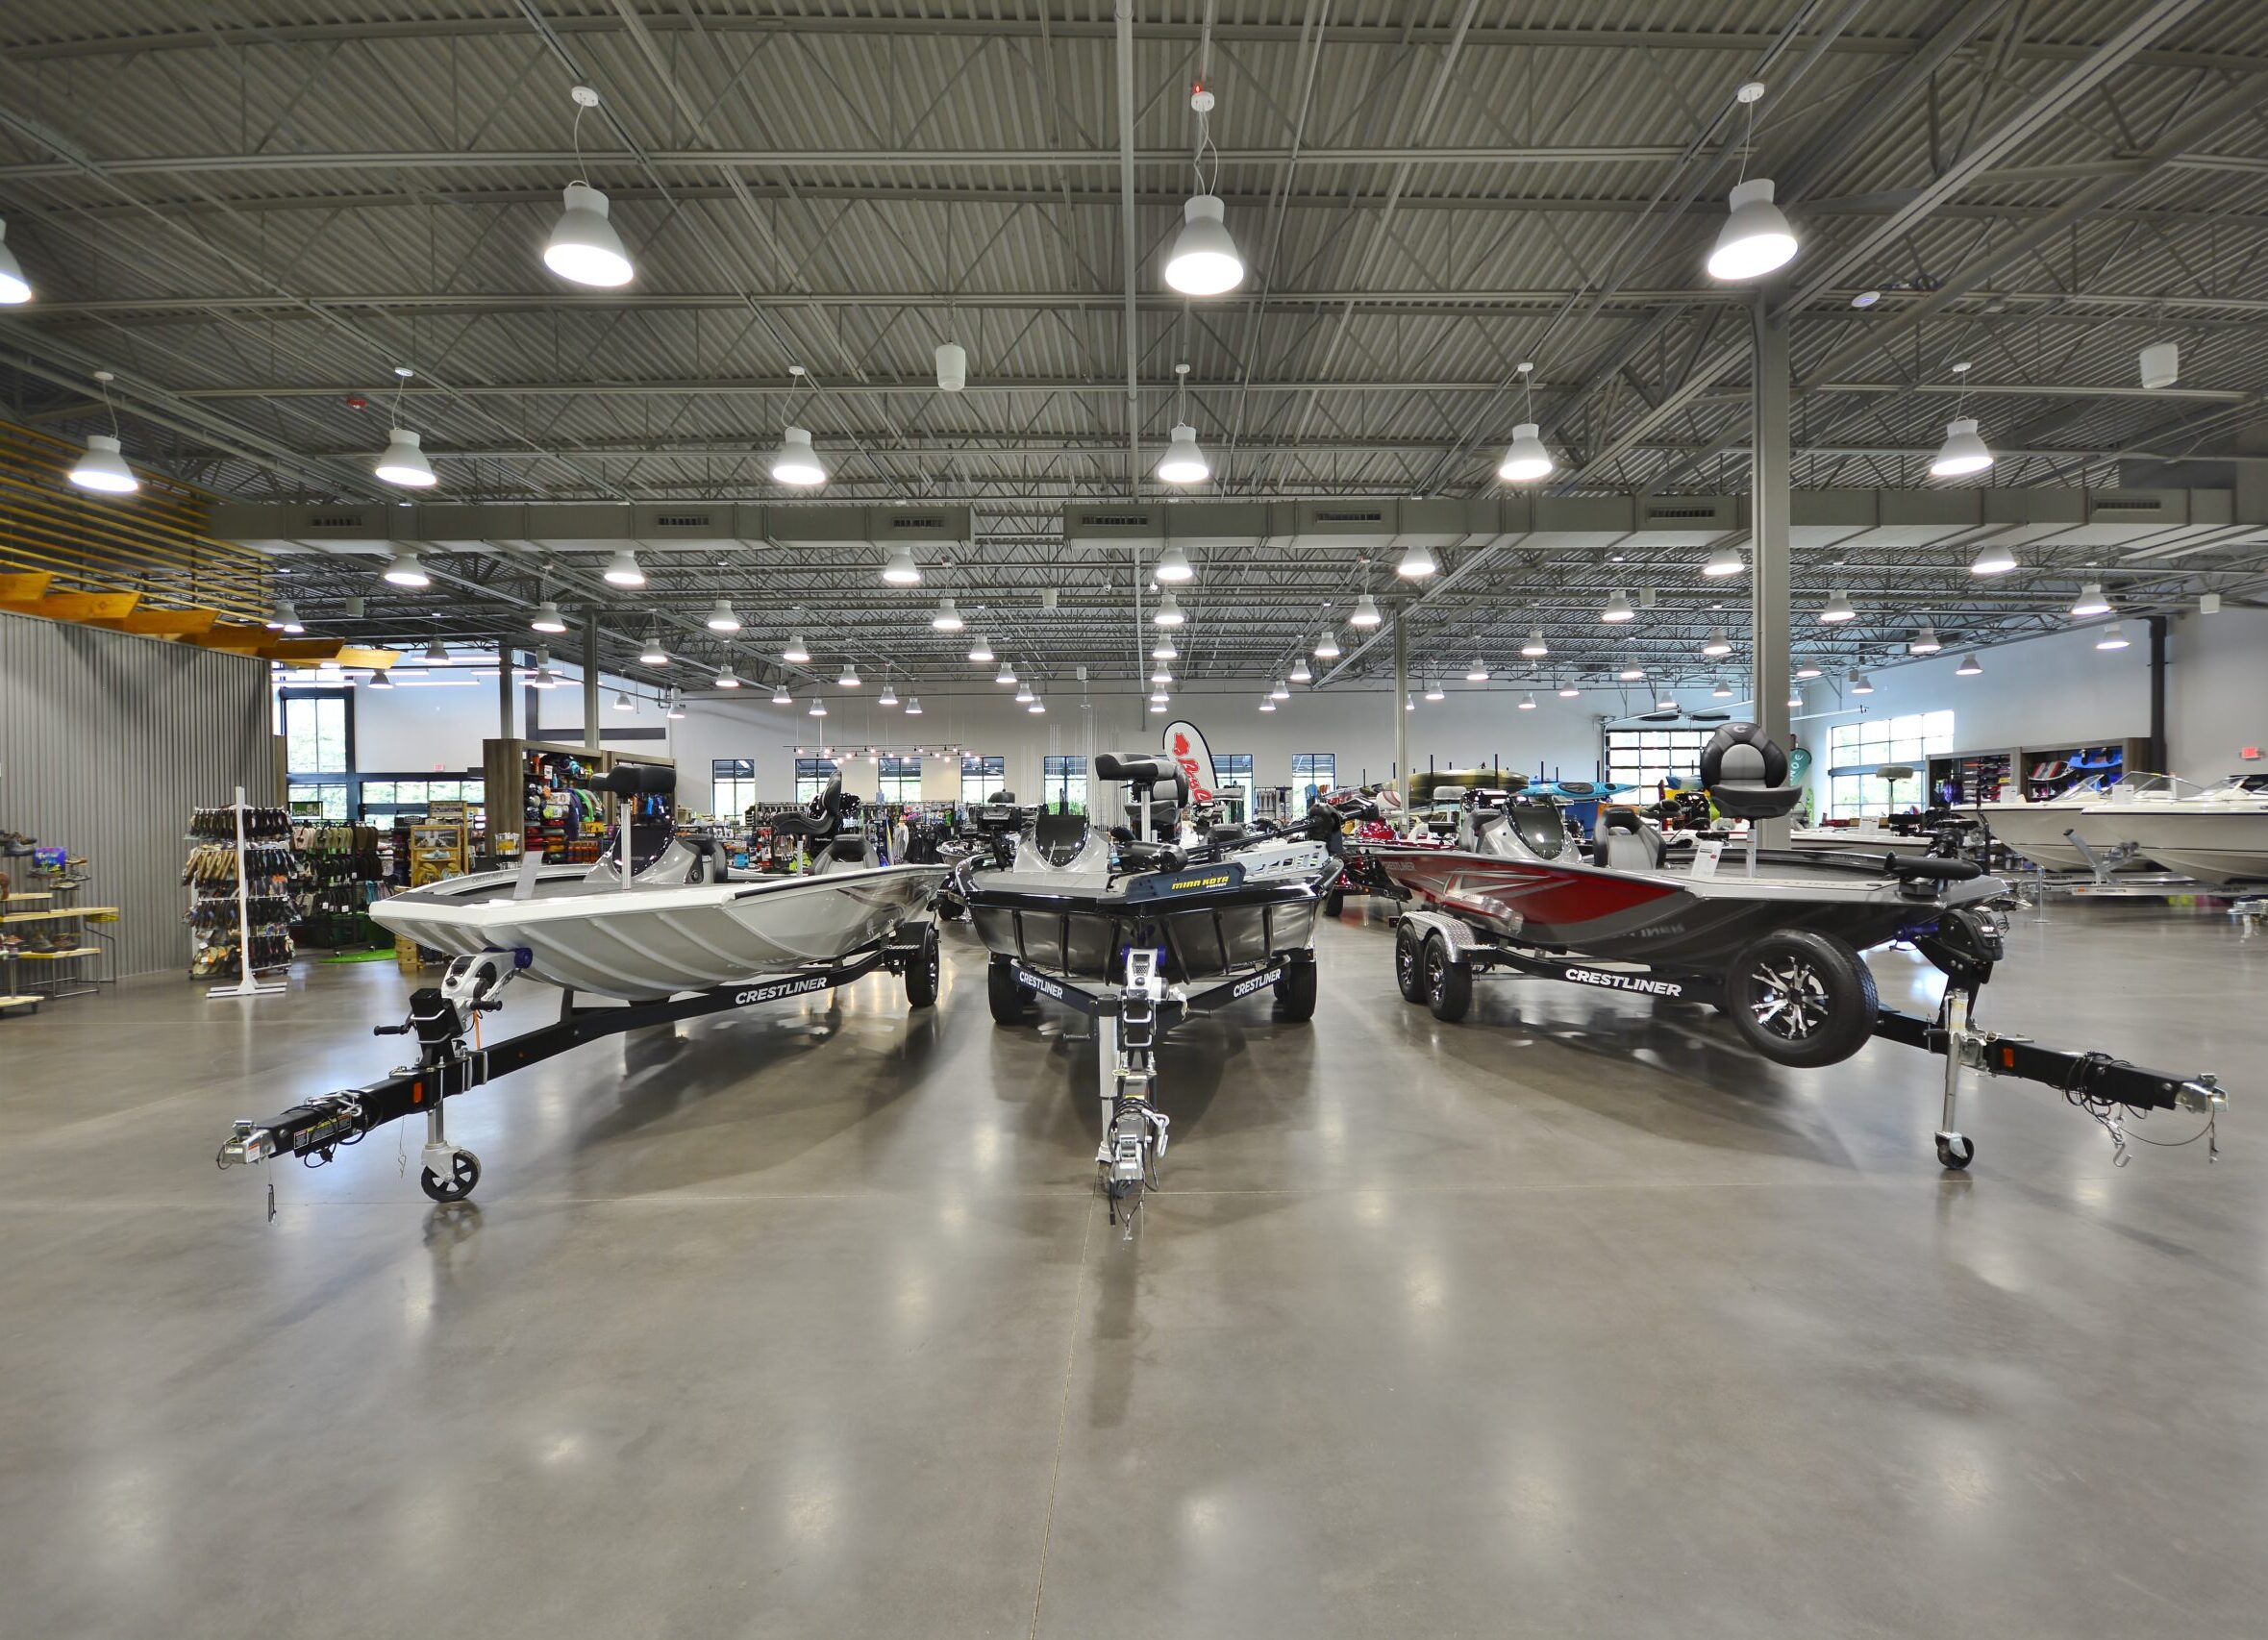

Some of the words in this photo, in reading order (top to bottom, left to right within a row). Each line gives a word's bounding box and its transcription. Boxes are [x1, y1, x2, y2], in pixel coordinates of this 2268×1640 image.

[1202, 876, 1230, 886] KOTA
[735, 977, 827, 1005] CRESTLINER
[1019, 971, 1063, 1000] CRESTLINER
[1233, 968, 1282, 998] CRESTLINER
[1565, 968, 1682, 997] CRESTLINER
